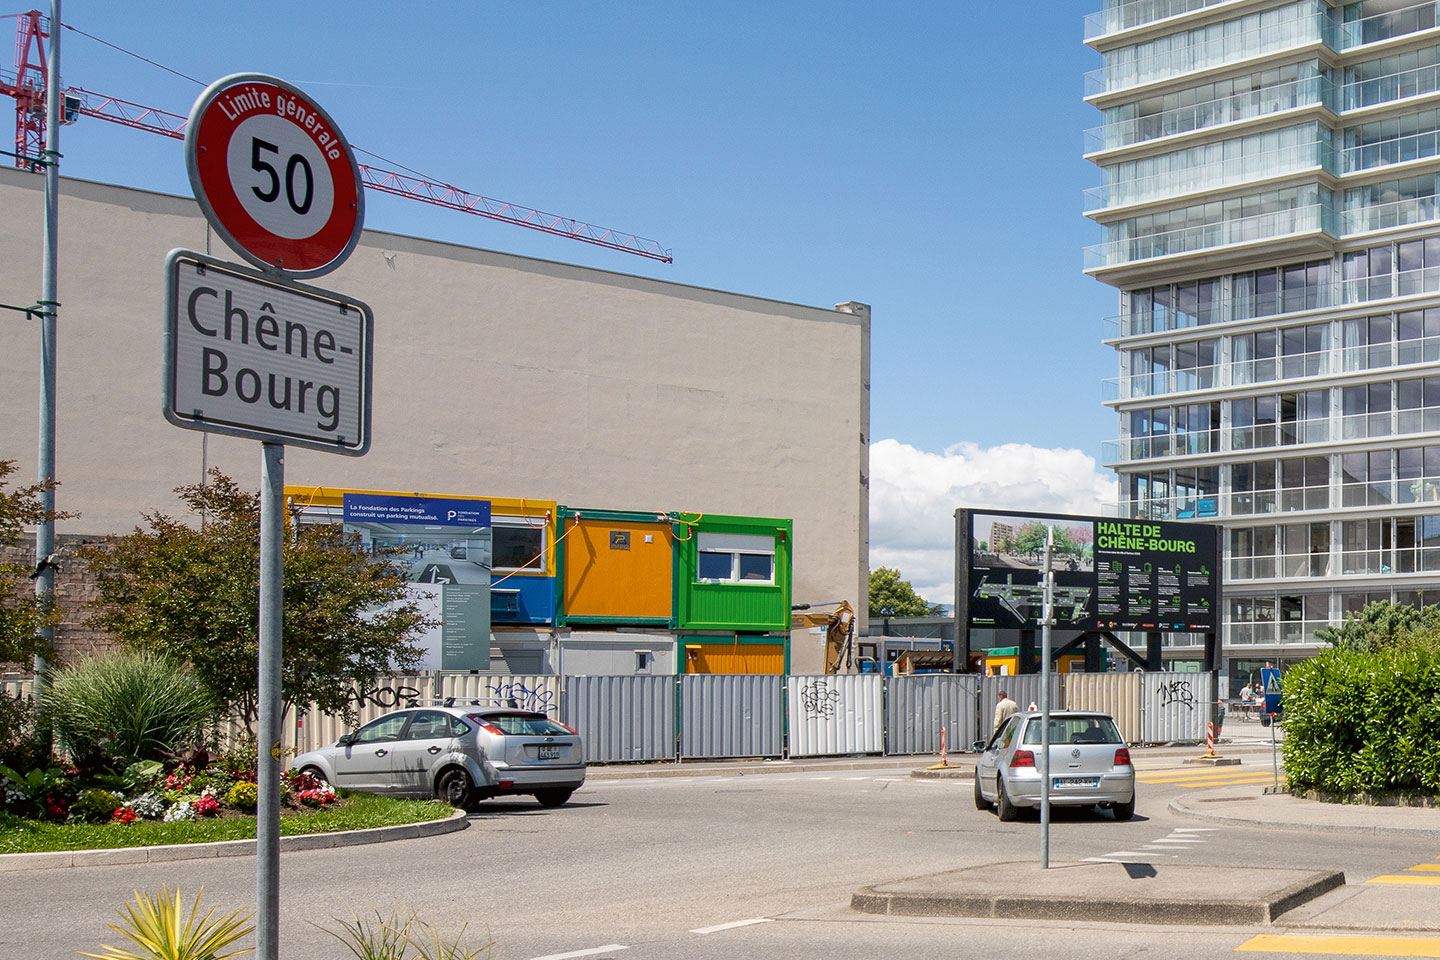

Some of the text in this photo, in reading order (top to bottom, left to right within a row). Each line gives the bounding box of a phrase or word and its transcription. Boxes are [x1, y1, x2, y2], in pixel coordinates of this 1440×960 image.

[218, 87, 341, 160] Limite générale
[251, 136, 314, 215] 50
[187, 286, 353, 364] Chêne-
[202, 346, 340, 431] Bourg
[386, 512, 408, 520] parking
[1097, 522, 1161, 538] HALTE DE
[1097, 534, 1196, 553] CHÊNE-BOURG
